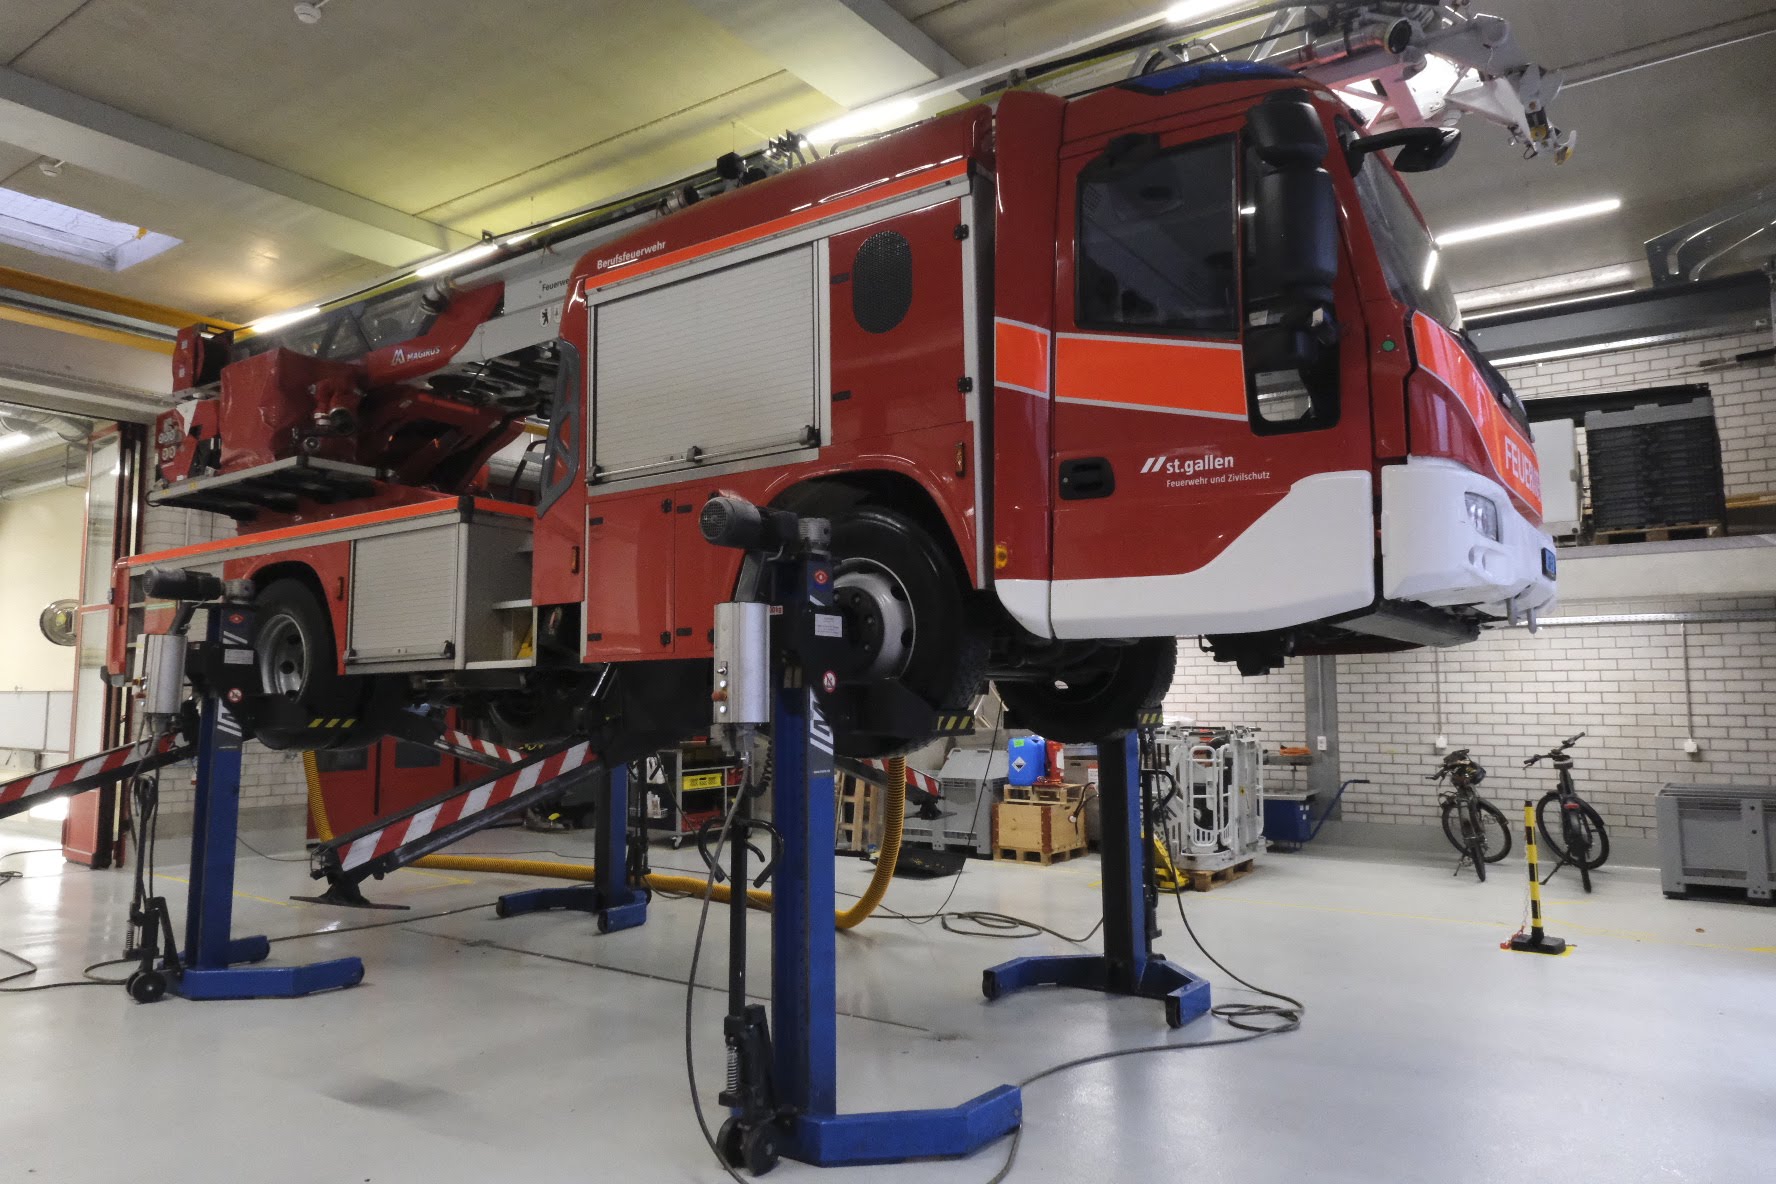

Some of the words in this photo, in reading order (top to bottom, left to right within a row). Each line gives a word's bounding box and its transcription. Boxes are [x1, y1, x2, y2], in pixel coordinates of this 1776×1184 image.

[597, 241, 666, 269] Berufsfeuerwehr
[407, 347, 441, 361] MAGIRUS
[1166, 455, 1234, 475] st.gallen
[1504, 435, 1540, 498] FEUER
[1166, 476, 1208, 488] Feuerwehr
[1210, 475, 1226, 484] und
[1228, 471, 1271, 483] Zivilschutz
